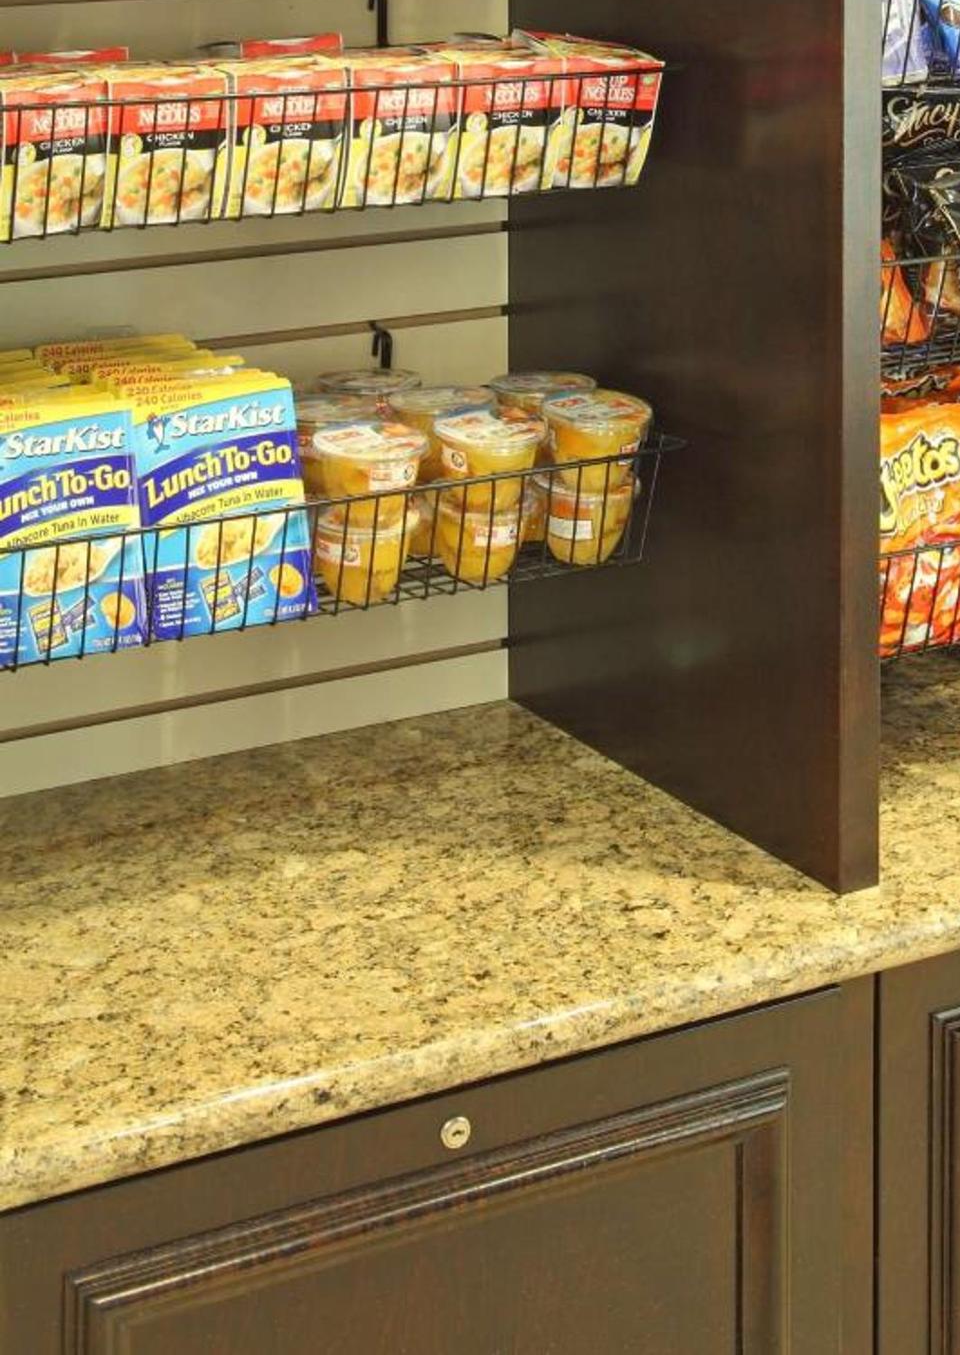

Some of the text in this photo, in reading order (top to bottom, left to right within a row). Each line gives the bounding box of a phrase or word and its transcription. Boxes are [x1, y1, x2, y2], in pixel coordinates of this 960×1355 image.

[160, 390, 203, 405] Calories
[171, 400, 287, 438] StarKist
[2, 423, 126, 460] StarKist
[143, 440, 292, 510] Lunch To-Go
[234, 471, 259, 484] OWN
[0, 472, 56, 520] unch
[69, 495, 95, 509] OWN
[218, 495, 241, 510] Tuna
[254, 486, 284, 500] Water
[51, 521, 75, 535] Tuna
[90, 512, 120, 525] Water
